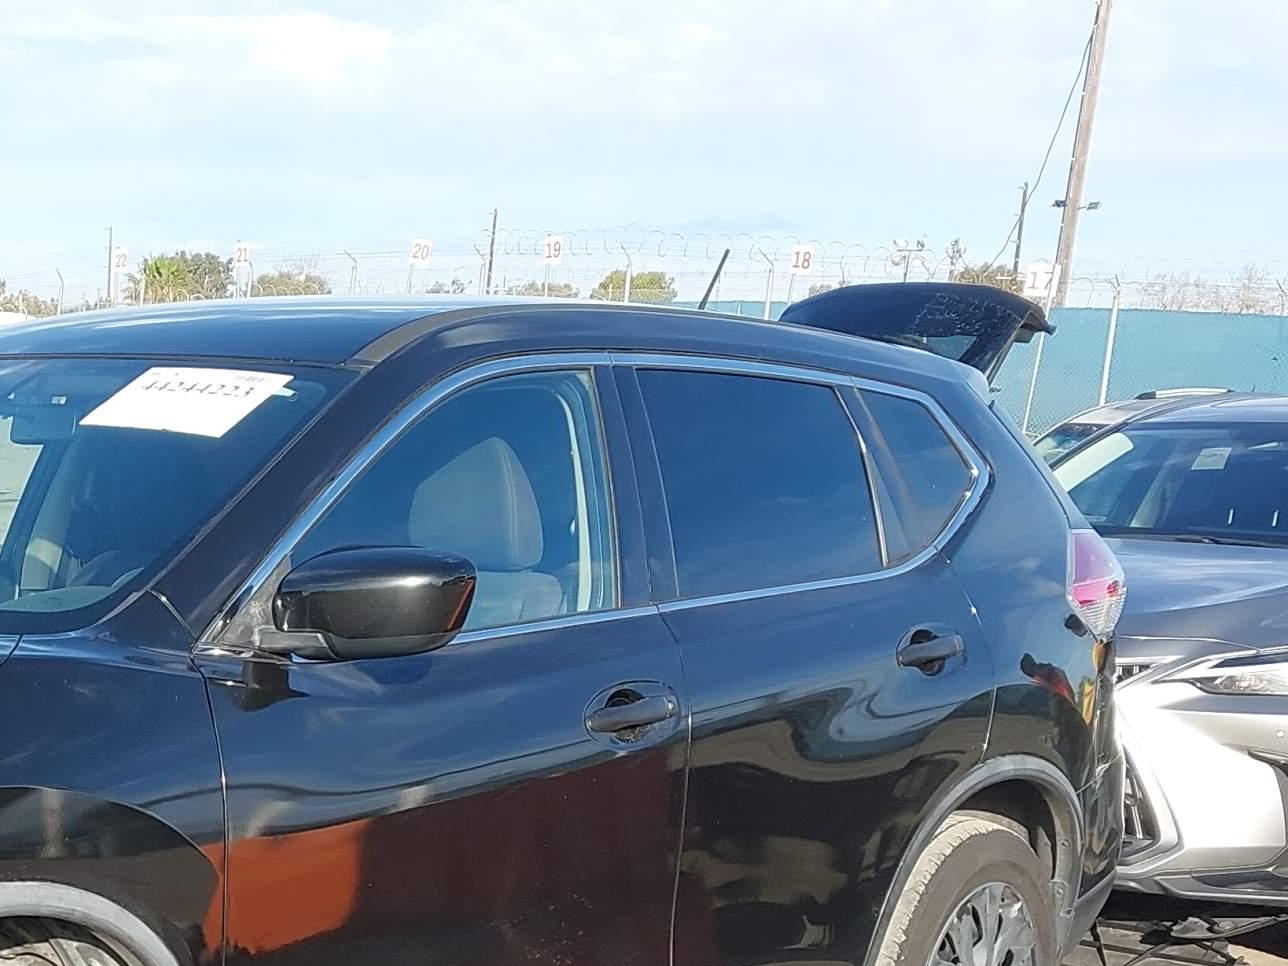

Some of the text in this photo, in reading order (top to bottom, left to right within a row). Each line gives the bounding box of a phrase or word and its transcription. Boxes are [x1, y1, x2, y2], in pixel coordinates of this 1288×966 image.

[236, 247, 249, 263] 21
[412, 243, 430, 260] 20
[545, 241, 562, 259] 19
[114, 253, 127, 267] 22
[792, 250, 812, 270] 18
[1028, 271, 1052, 290] 17
[141, 380, 255, 398] 44244223
